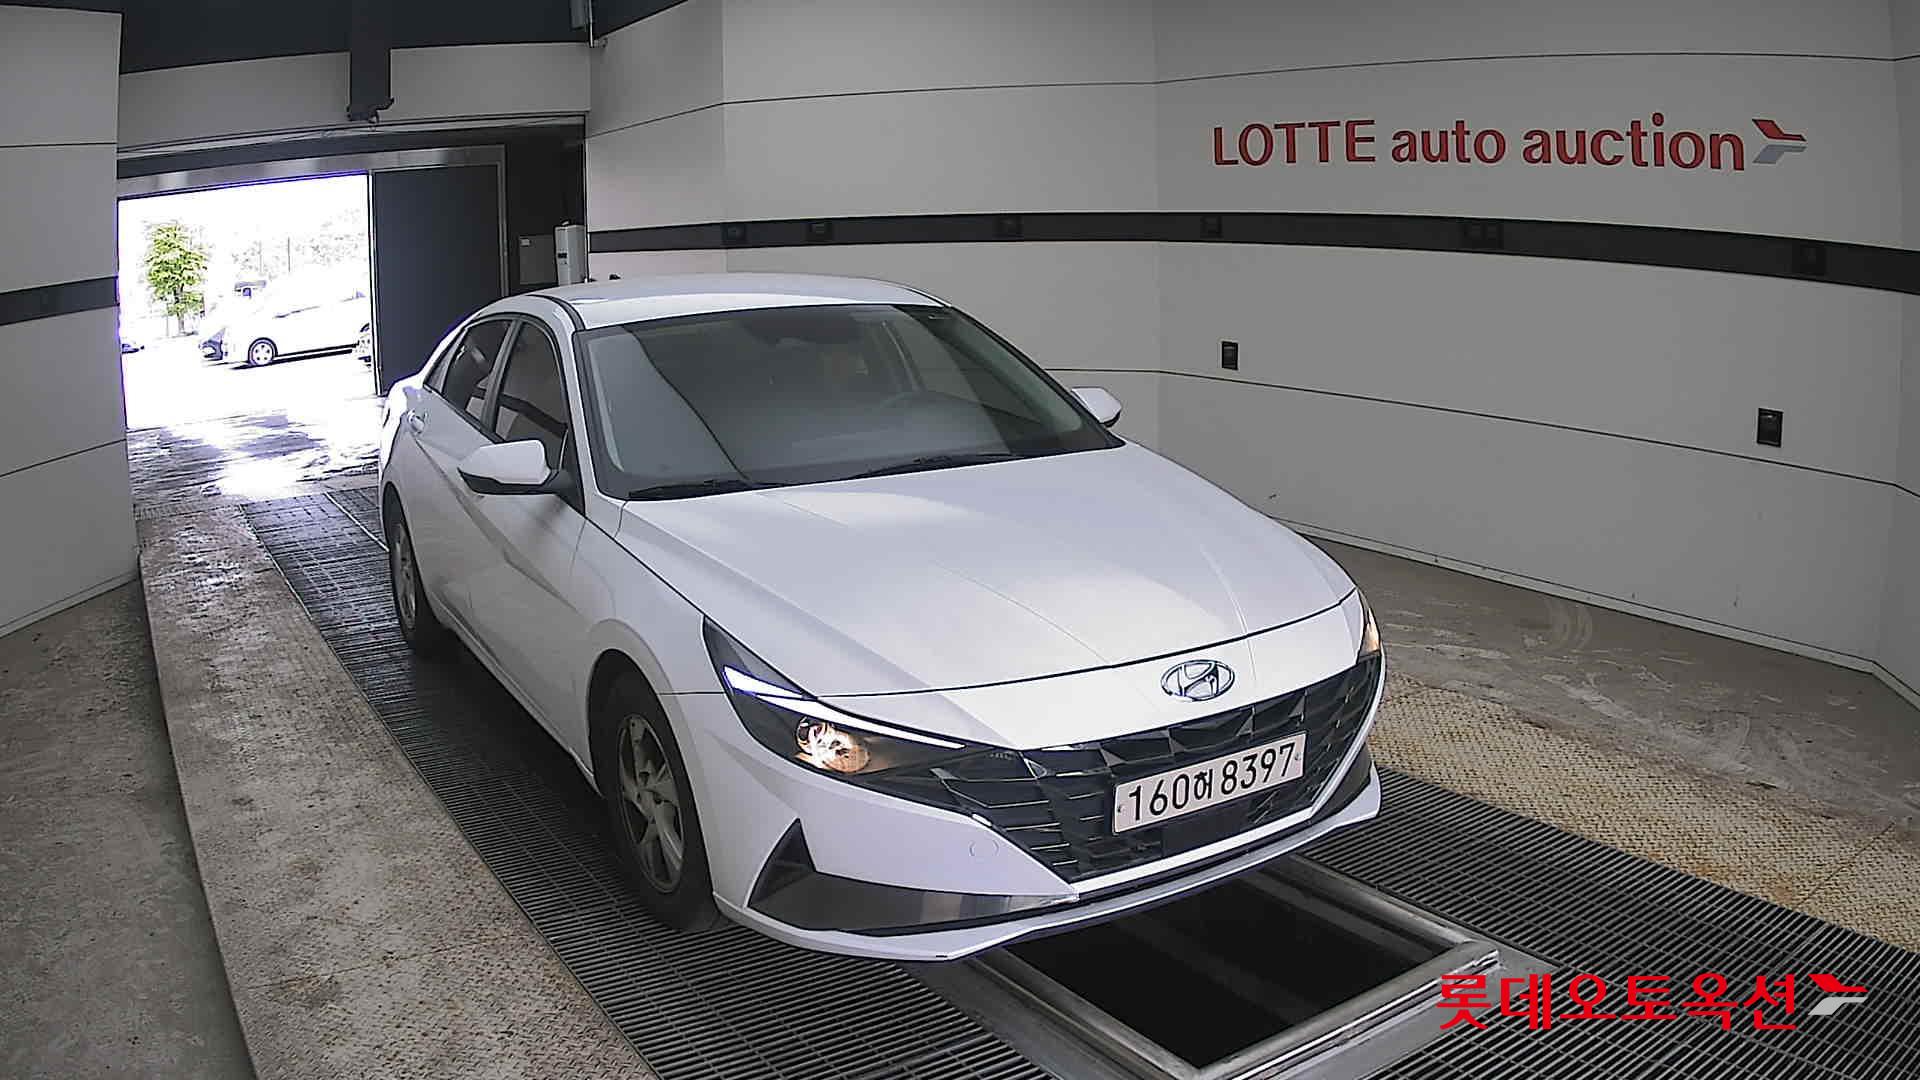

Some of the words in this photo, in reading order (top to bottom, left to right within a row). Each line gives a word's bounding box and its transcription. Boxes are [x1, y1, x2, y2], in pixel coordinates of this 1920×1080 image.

[1213, 120, 1376, 165] LOTTE
[1392, 119, 1507, 164] auto
[1523, 112, 1745, 171] auction
[1221, 743, 1296, 796] 8397
